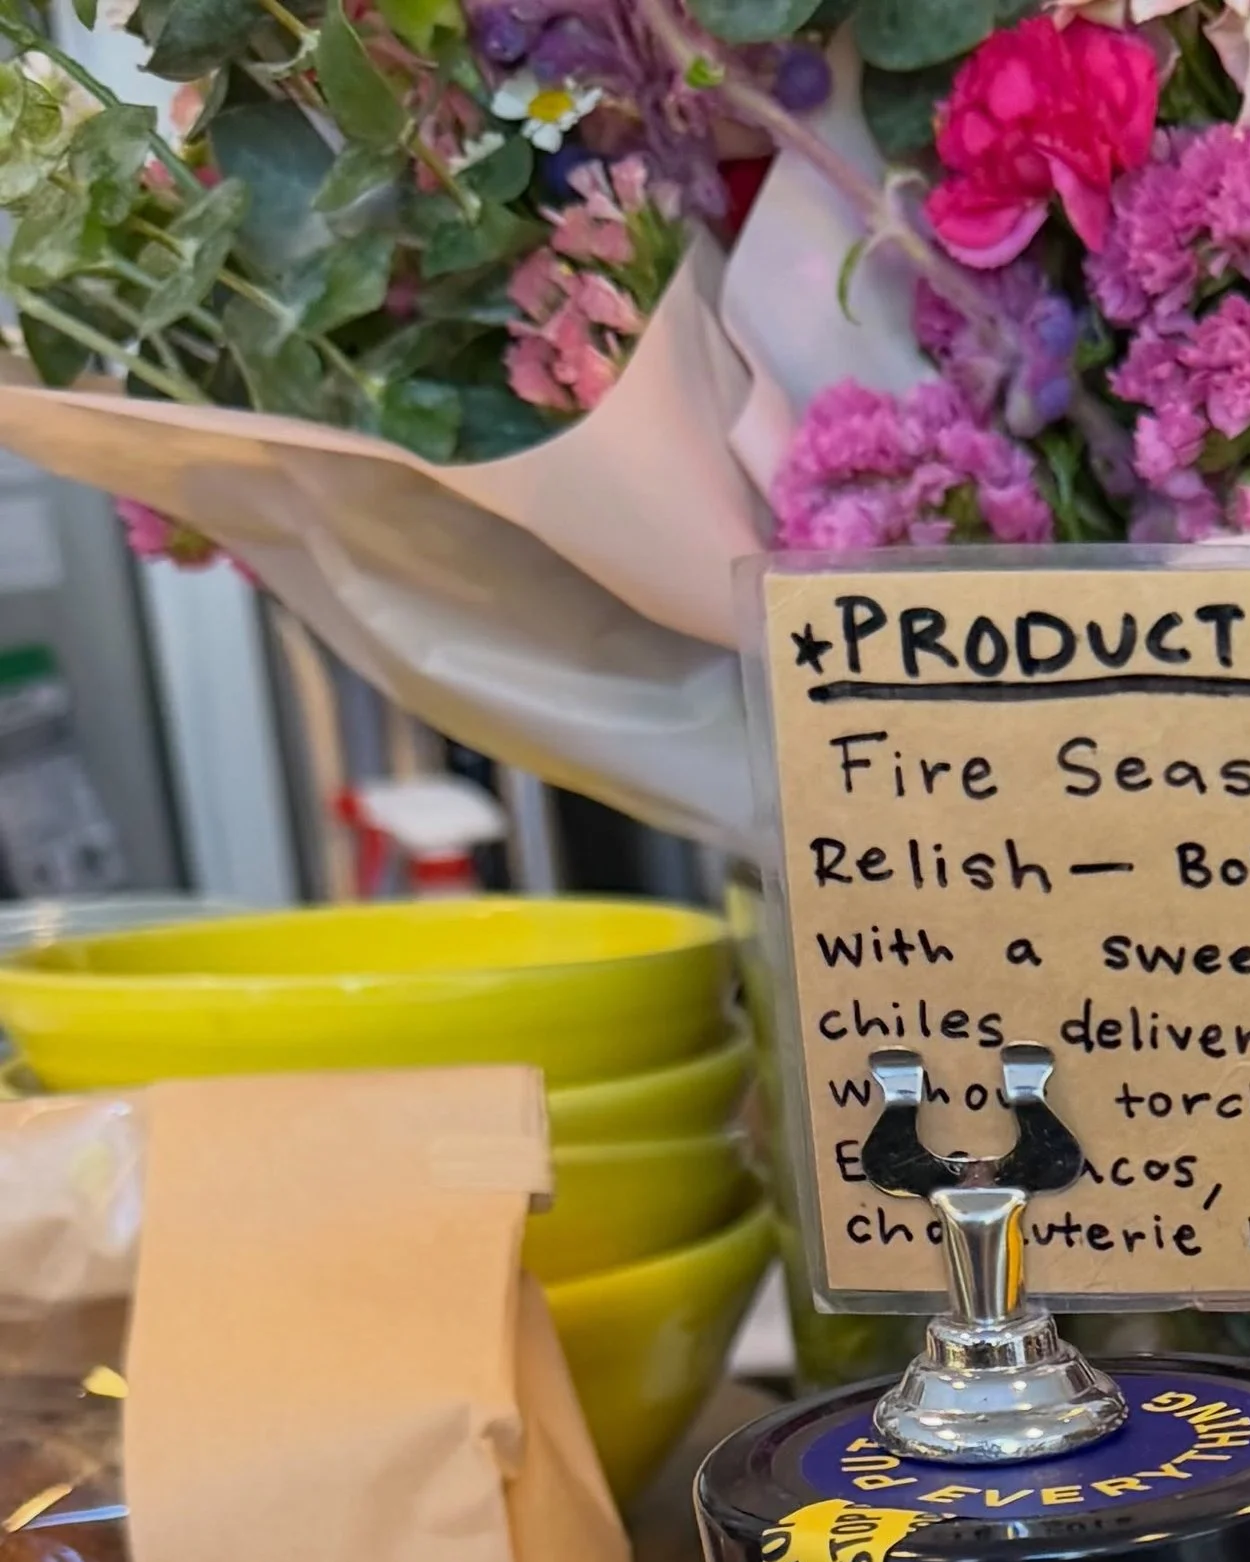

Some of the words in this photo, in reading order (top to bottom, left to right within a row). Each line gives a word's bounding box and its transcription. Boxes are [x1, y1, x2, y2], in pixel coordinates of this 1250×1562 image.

[836, 595, 1246, 677] PRODUCT
[830, 730, 999, 800] Fire
[1007, 936, 1042, 967] a
[818, 1000, 1006, 1048] chiles
